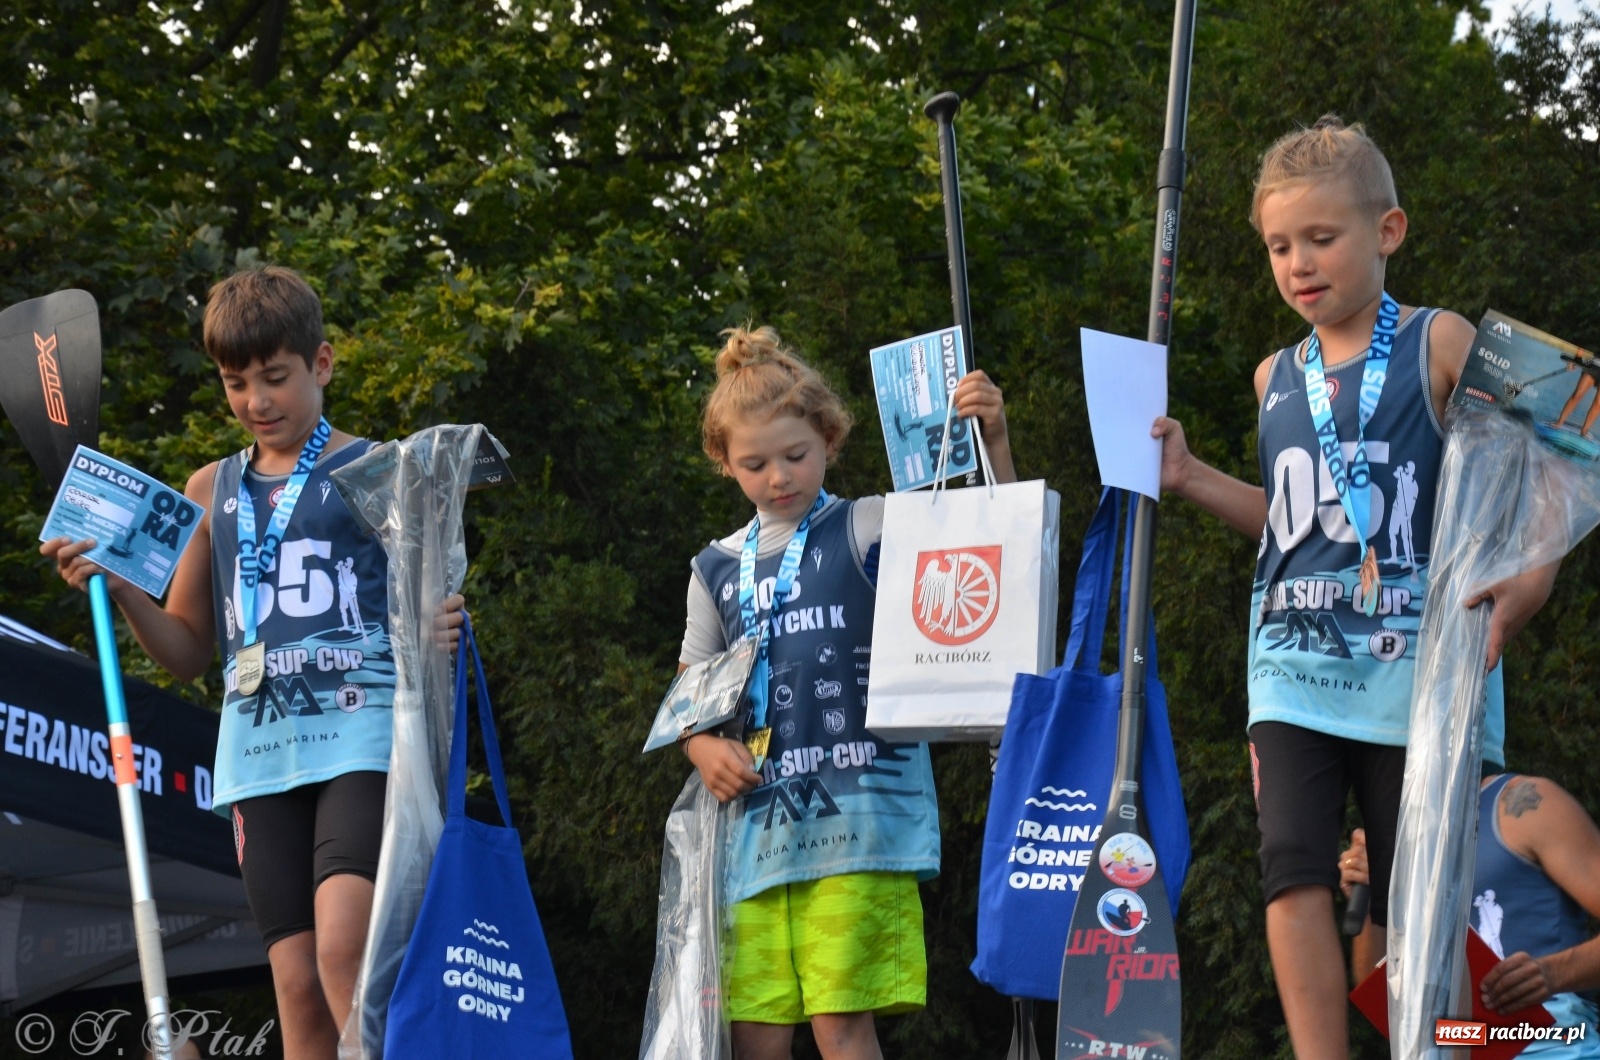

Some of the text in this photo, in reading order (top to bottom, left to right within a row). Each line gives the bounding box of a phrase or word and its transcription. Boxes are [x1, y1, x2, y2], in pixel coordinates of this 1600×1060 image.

[1366, 300, 1399, 361] ODRA
[1478, 346, 1510, 370] SOLID
[1306, 369, 1332, 417] SUP
[1359, 368, 1387, 424] SUP
[292, 423, 331, 475] ODRA
[1316, 417, 1349, 499] ODRA
[76, 456, 145, 495] DYPLOM
[238, 489, 256, 533] SUP
[273, 482, 302, 530] SUP
[141, 511, 181, 551] RA
[239, 540, 257, 589] CUP
[740, 547, 757, 592] SUP
[779, 538, 804, 587] SUP
[1293, 579, 1343, 610] SUP
[829, 605, 846, 629] K
[265, 648, 309, 679] SUP
[316, 646, 363, 672] CUP
[915, 648, 992, 665] RACIBÓRZ
[1380, 636, 1396, 654] B
[345, 691, 358, 707] B
[1296, 673, 1368, 692] MARINA
[0, 702, 214, 811] ERANSER D
[244, 731, 340, 758] AQUA MARINA
[780, 745, 825, 778] SUP
[832, 741, 878, 770] CUP
[757, 833, 859, 863] AQUA MARINA
[1008, 843, 1092, 867] ÓRNE
[1009, 871, 1086, 892] ODRY
[446, 946, 523, 981] KRAINA
[443, 967, 525, 1004] GÓRNEJ
[458, 994, 511, 1023] ODRY
[1088, 1040, 1147, 1060] RTW
